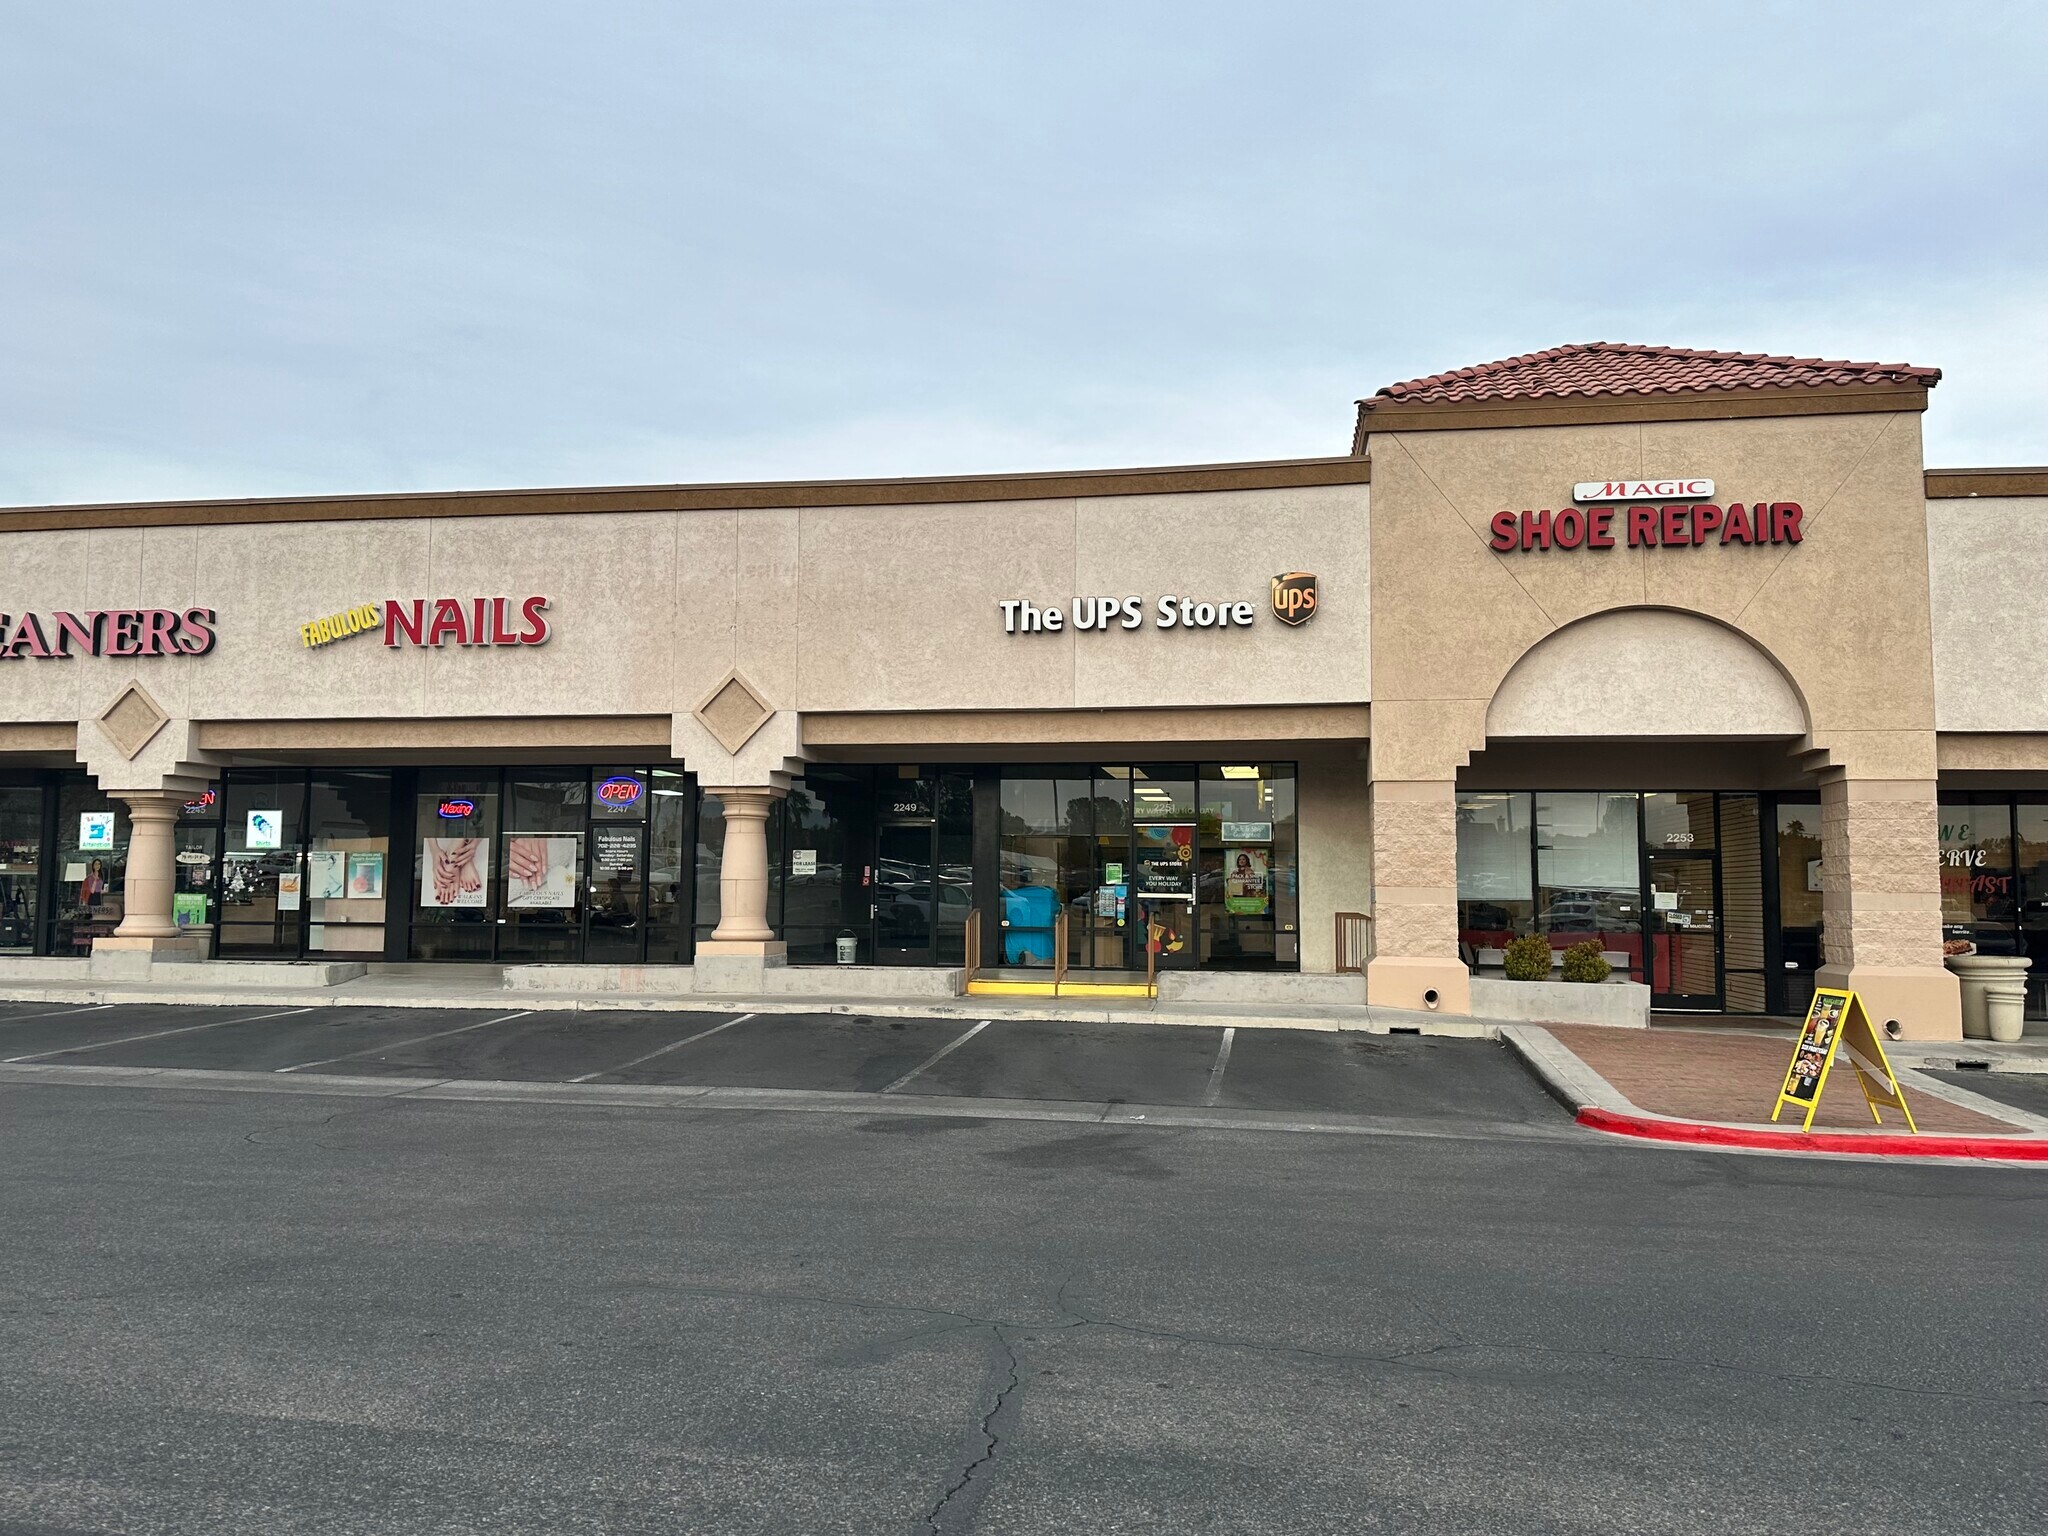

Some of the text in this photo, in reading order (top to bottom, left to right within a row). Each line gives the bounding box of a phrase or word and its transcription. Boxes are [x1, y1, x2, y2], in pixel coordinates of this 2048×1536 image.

[1583, 481, 1707, 499] MAGIC
[1489, 502, 1804, 552] SHOE REPAIR
[1275, 588, 1315, 617] ups
[301, 597, 550, 648] FABULOUS NAILS
[999, 595, 1254, 633] The UPS Store
[0, 607, 216, 658] ANERS
[600, 784, 639, 799] OPEN
[440, 803, 472, 816] Waxing
[893, 803, 917, 812] 2249
[1153, 803, 1176, 813] 2251
[1666, 833, 1694, 843] 2253
[1938, 849, 1987, 867] ERVE
